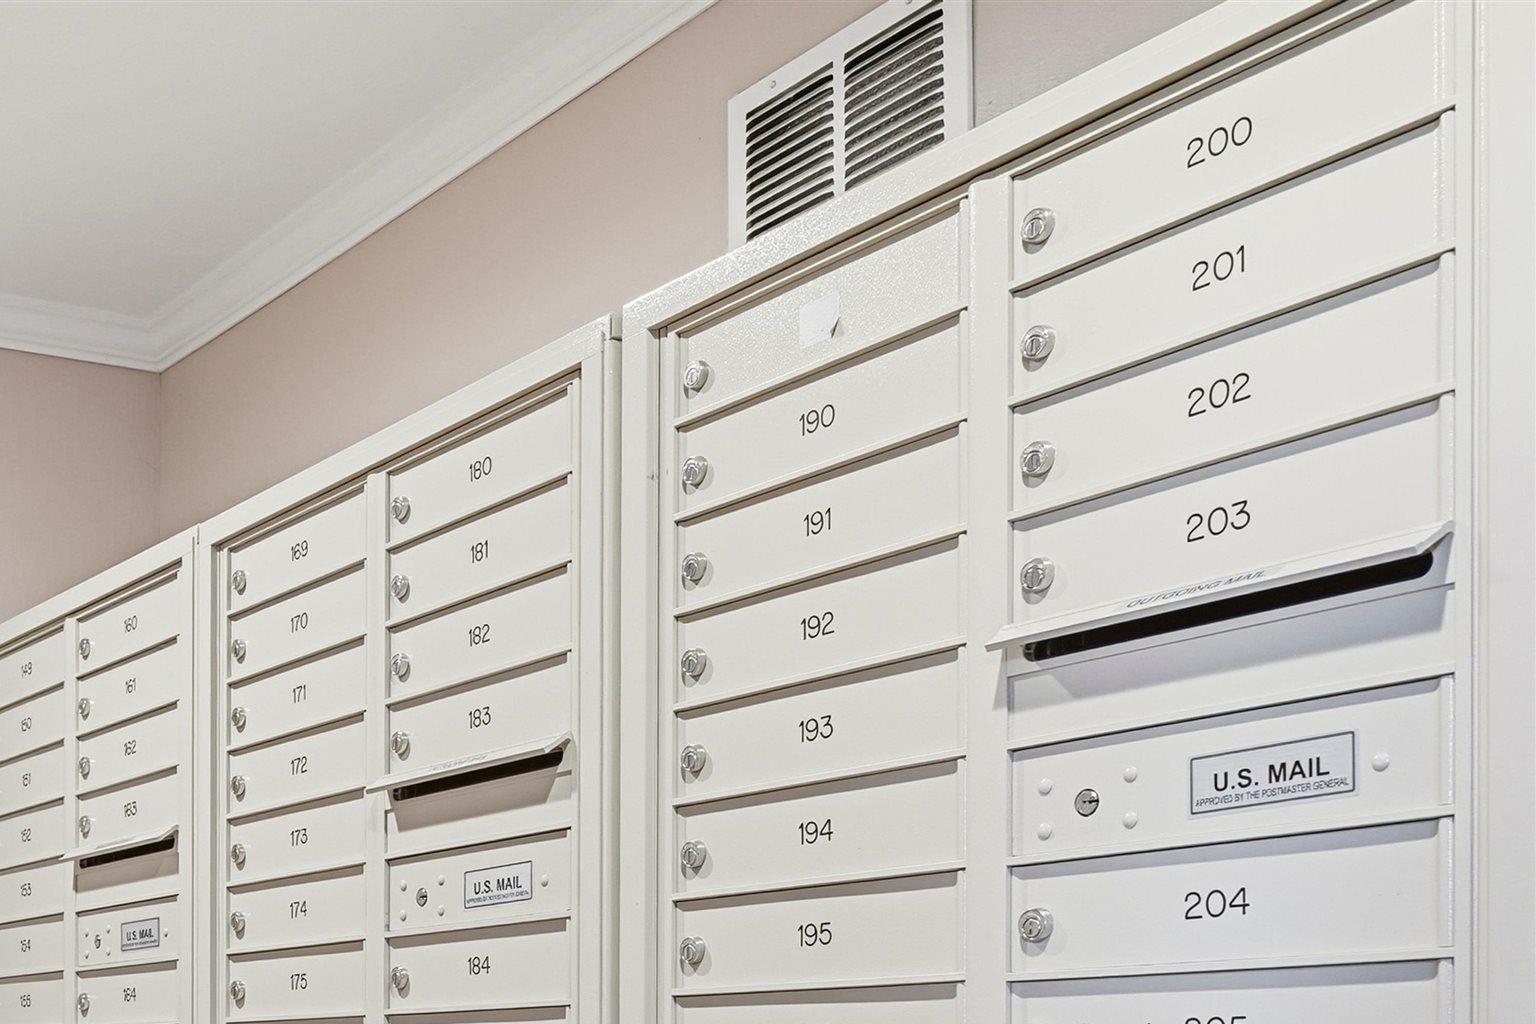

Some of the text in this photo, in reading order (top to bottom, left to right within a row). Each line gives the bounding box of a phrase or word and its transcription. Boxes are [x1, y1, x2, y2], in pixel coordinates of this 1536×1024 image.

[1186, 116, 1253, 169] 200
[1191, 244, 1245, 292] 201
[1187, 372, 1252, 418] 202
[798, 403, 836, 437] 190
[468, 456, 493, 483] 180
[803, 507, 832, 537] 191
[1186, 499, 1251, 543] 203
[290, 539, 309, 562] 169
[470, 539, 489, 564] 181
[1127, 569, 1266, 608] OUTGOING MAIL
[123, 614, 138, 633] 160
[290, 611, 309, 634] 170
[800, 611, 836, 641] 192
[468, 623, 491, 648] 182
[124, 677, 137, 694] 161
[292, 684, 307, 704] 171
[468, 705, 492, 730] 183
[798, 714, 834, 743] 193
[123, 739, 137, 757] 162
[290, 755, 308, 776] 172
[1213, 756, 1330, 792] U.S. MAIL
[1195, 777, 1350, 808] APPROVED BY THE POSTMASTER GENERAL
[123, 800, 138, 818] 163
[289, 827, 309, 847] 173
[797, 818, 834, 846] 194
[474, 876, 522, 895] U.S. MAIL
[289, 900, 308, 920] 174
[1184, 886, 1251, 921] 204
[797, 921, 833, 948] 195
[467, 955, 491, 976] 184
[289, 972, 308, 991] 175
[122, 987, 137, 1003] 164
